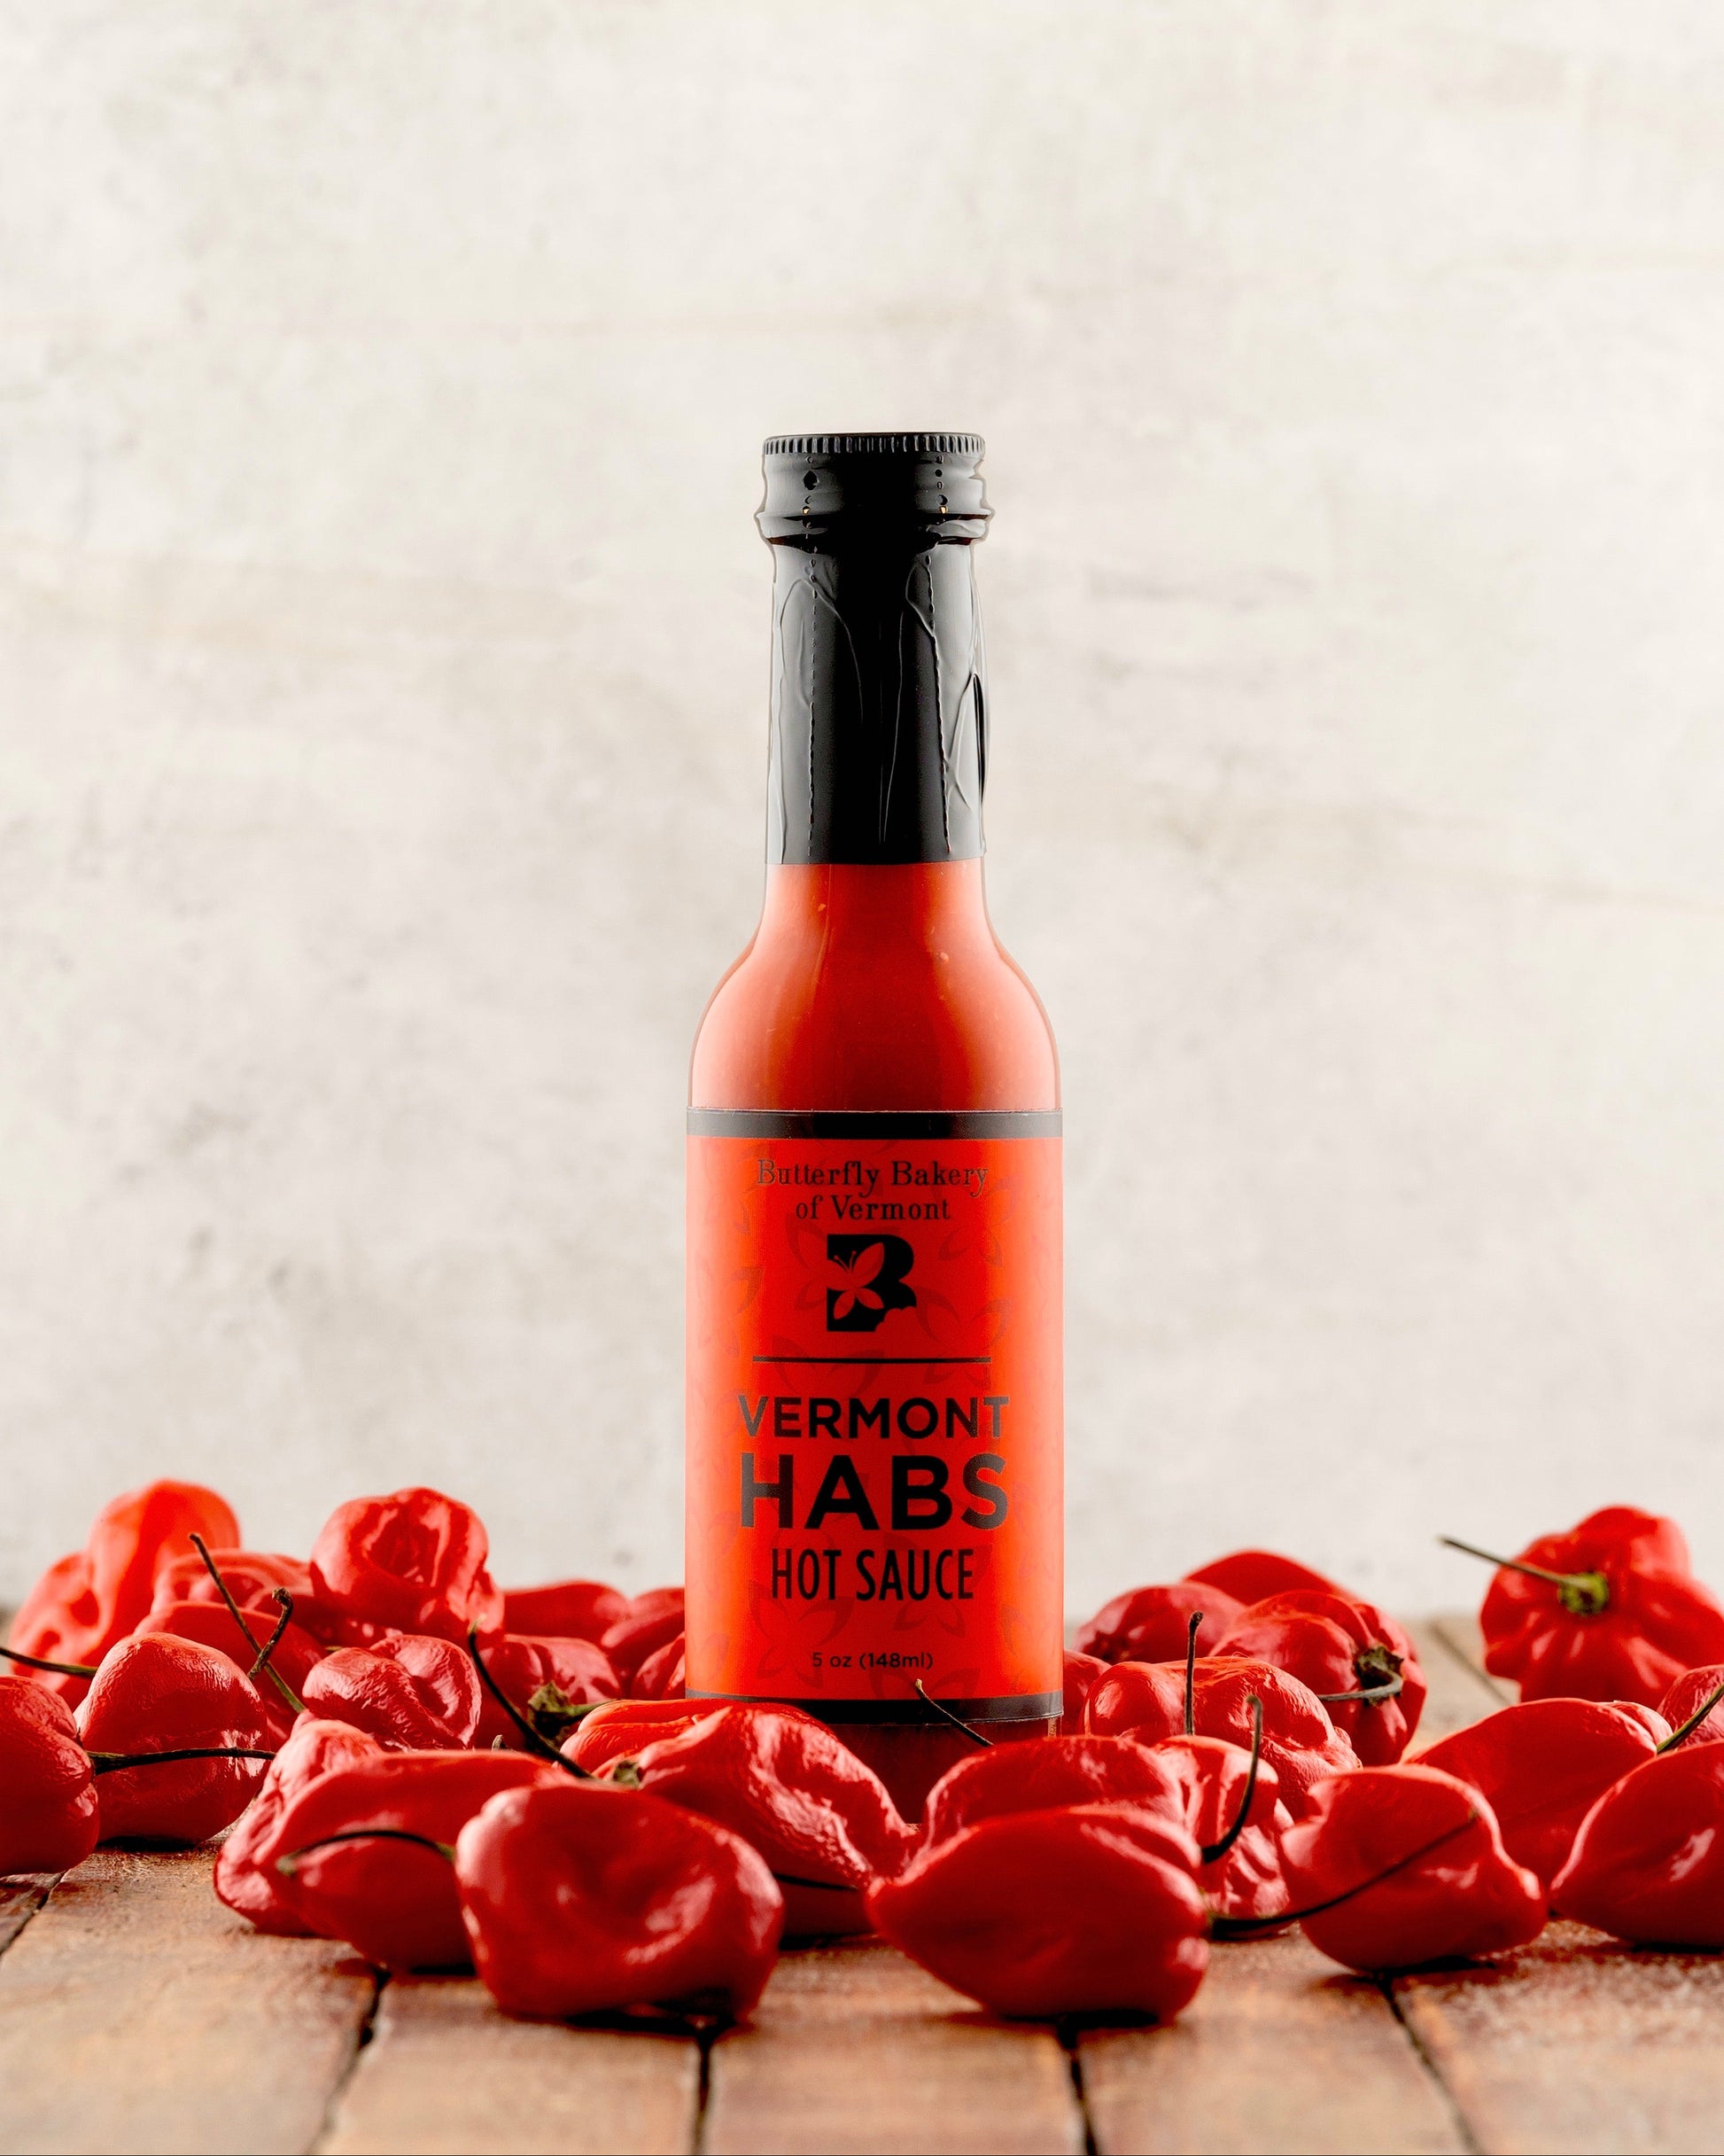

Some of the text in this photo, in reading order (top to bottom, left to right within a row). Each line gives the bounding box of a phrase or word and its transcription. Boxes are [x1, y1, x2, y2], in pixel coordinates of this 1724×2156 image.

[757, 1159, 989, 1197] Butterfly Bakery
[796, 1195, 951, 1220] of Vermont
[738, 1395, 1010, 1440] VERMONT
[740, 1452, 1009, 1531] HABS
[772, 1548, 975, 1601] HOT SAUCE
[812, 1652, 934, 1670] 5 oz (148ml)
